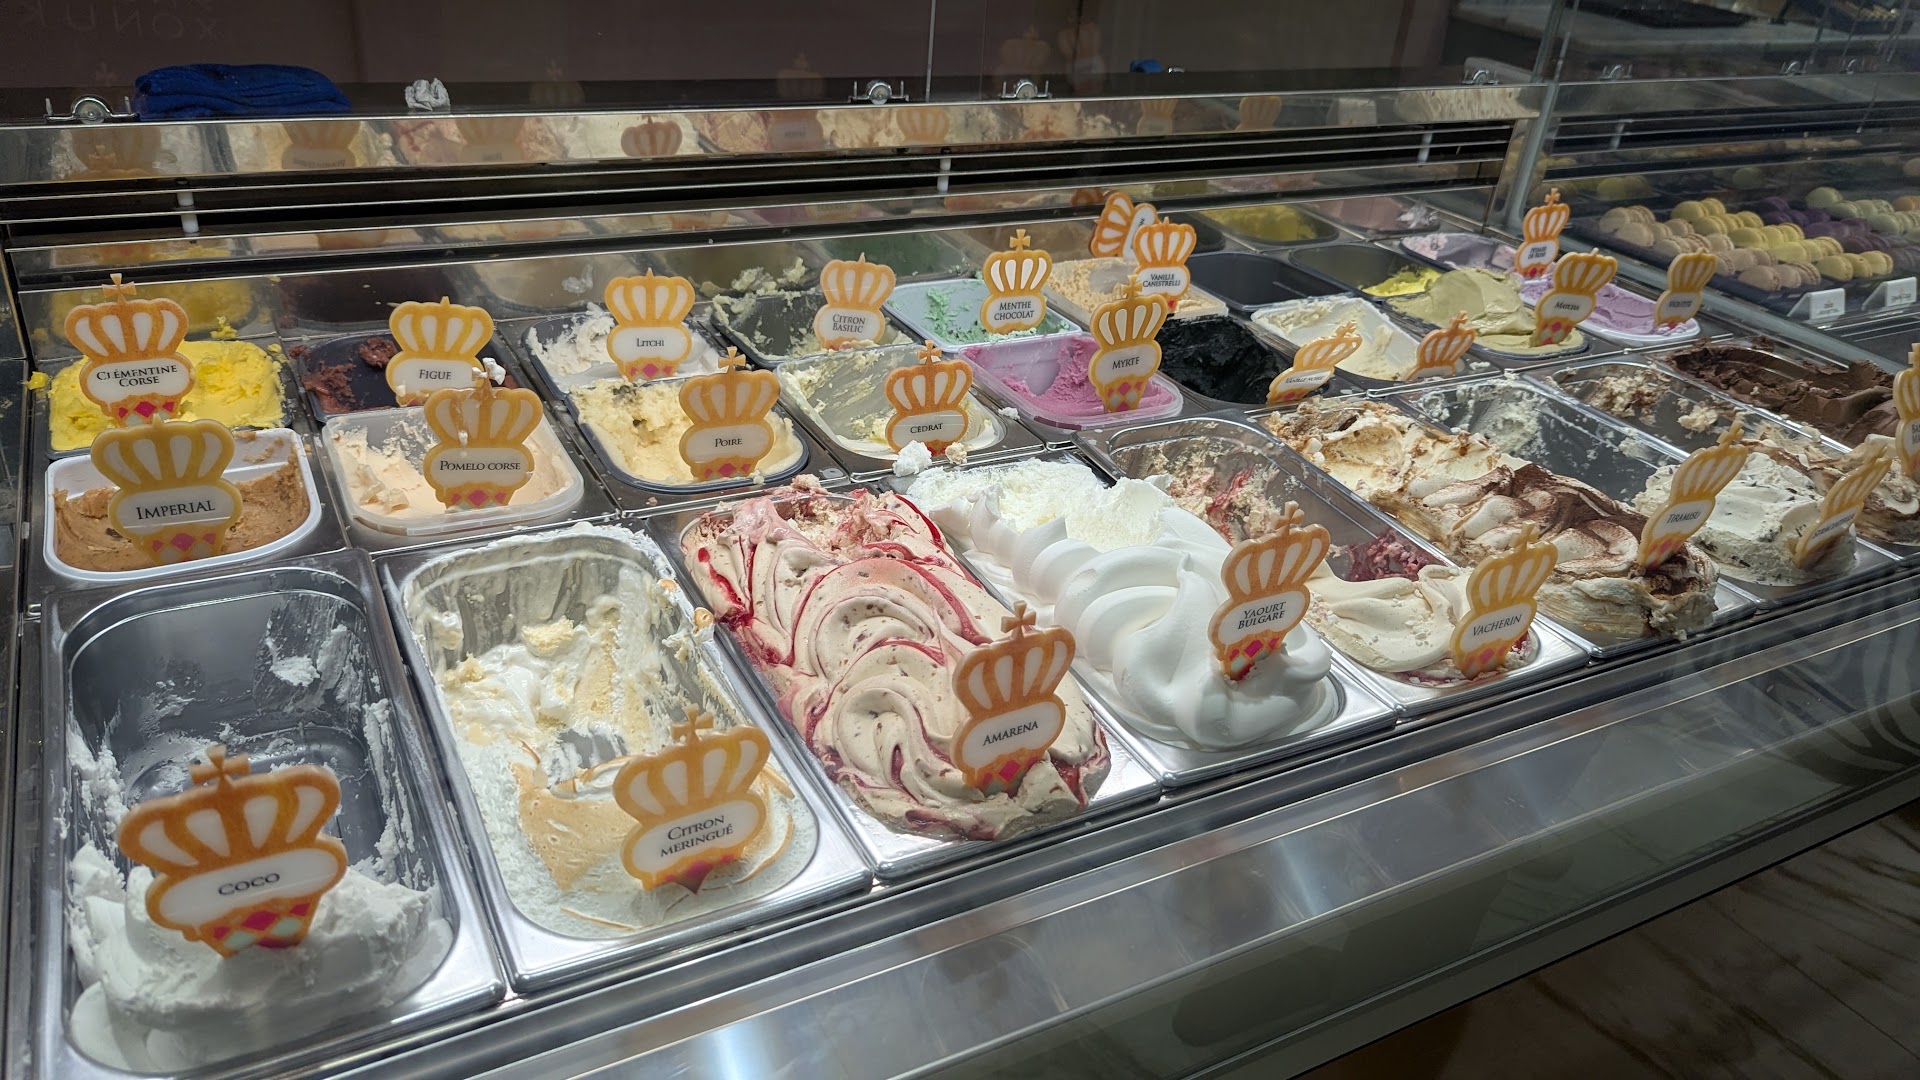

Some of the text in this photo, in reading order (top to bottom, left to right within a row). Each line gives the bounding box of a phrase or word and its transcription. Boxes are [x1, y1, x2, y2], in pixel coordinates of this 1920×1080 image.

[999, 301, 1032, 310] MENTHE
[832, 313, 866, 325] CITRON
[993, 310, 1035, 320] CHOCOLAT
[832, 323, 863, 333] BASILIC
[636, 338, 665, 347] LITCHI
[1112, 357, 1140, 370] MYRTE
[96, 365, 178, 380] CLÉMENTINE
[419, 369, 452, 380] FIGUE
[119, 376, 160, 387] CORSE
[910, 423, 943, 434] CEDRAT
[715, 438, 742, 448] POIRE
[439, 460, 521, 471] POMELO CORSE
[136, 500, 216, 520] IMPERIAL
[1244, 601, 1286, 619] YAOURT
[1237, 610, 1285, 630] BULGARE
[1473, 614, 1522, 636] VACHERIN
[982, 720, 1039, 746] AMARENA
[667, 815, 725, 840] CITRON
[660, 823, 734, 857] MERINGUÉ
[218, 872, 280, 895] COCO
